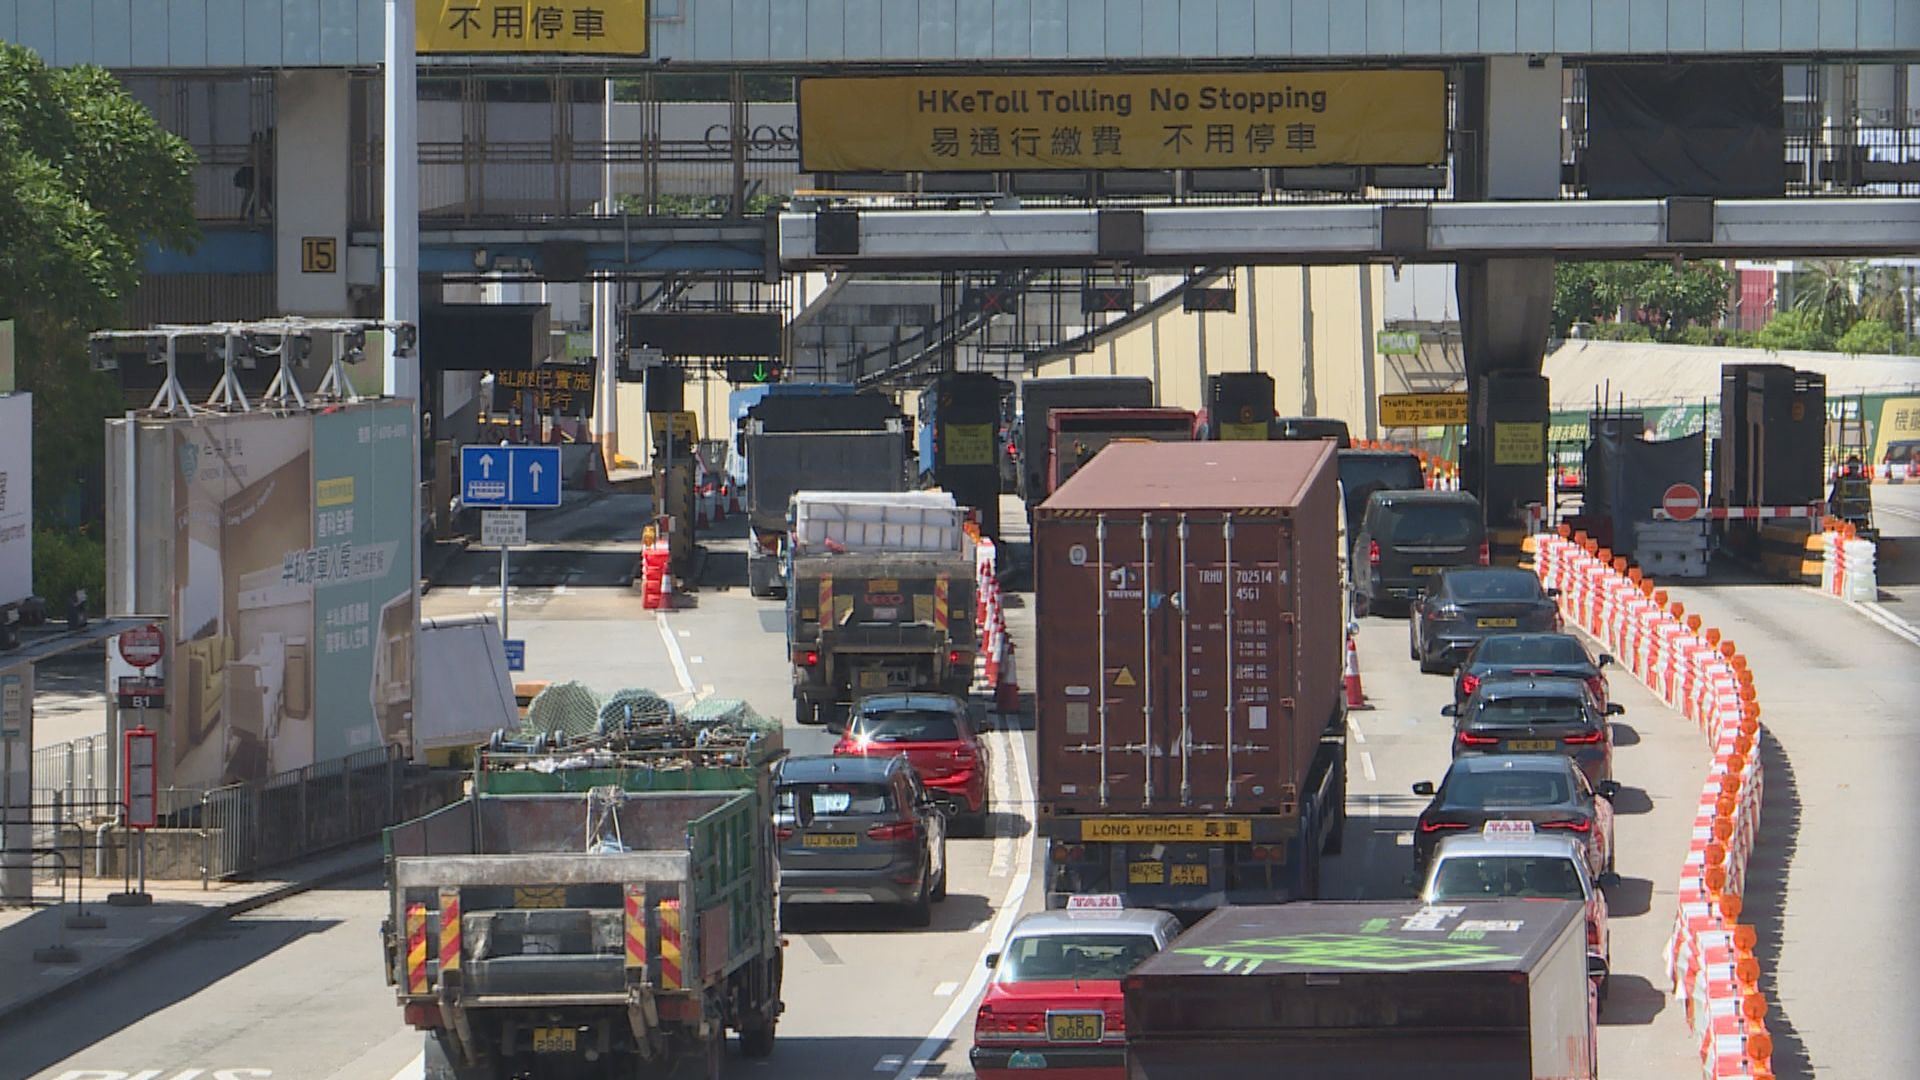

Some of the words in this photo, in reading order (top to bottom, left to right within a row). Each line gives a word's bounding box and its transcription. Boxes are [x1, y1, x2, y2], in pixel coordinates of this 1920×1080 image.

[448, 6, 606, 41] 不用停車
[917, 89, 1030, 114] HKeToll
[1037, 88, 1132, 116] Tolling
[1150, 88, 1190, 111] No
[1197, 86, 1328, 114] Stopping
[930, 124, 1122, 157] 易通行繳費
[1162, 123, 1319, 155] 不用停車
[307, 241, 331, 270] 15
[1384, 399, 1413, 408] Traffic
[1199, 570, 1223, 583] TRHU
[1236, 570, 1272, 583] 702514
[1280, 570, 1288, 583] 4
[1236, 588, 1260, 600] 45G1
[133, 697, 150, 707] B1
[1093, 823, 1131, 836] LONG
[1136, 823, 1194, 836] VEHICLE
[1204, 822, 1241, 838] 長車
[1488, 822, 1531, 831] TAXI
[1072, 896, 1119, 908] TAXI
